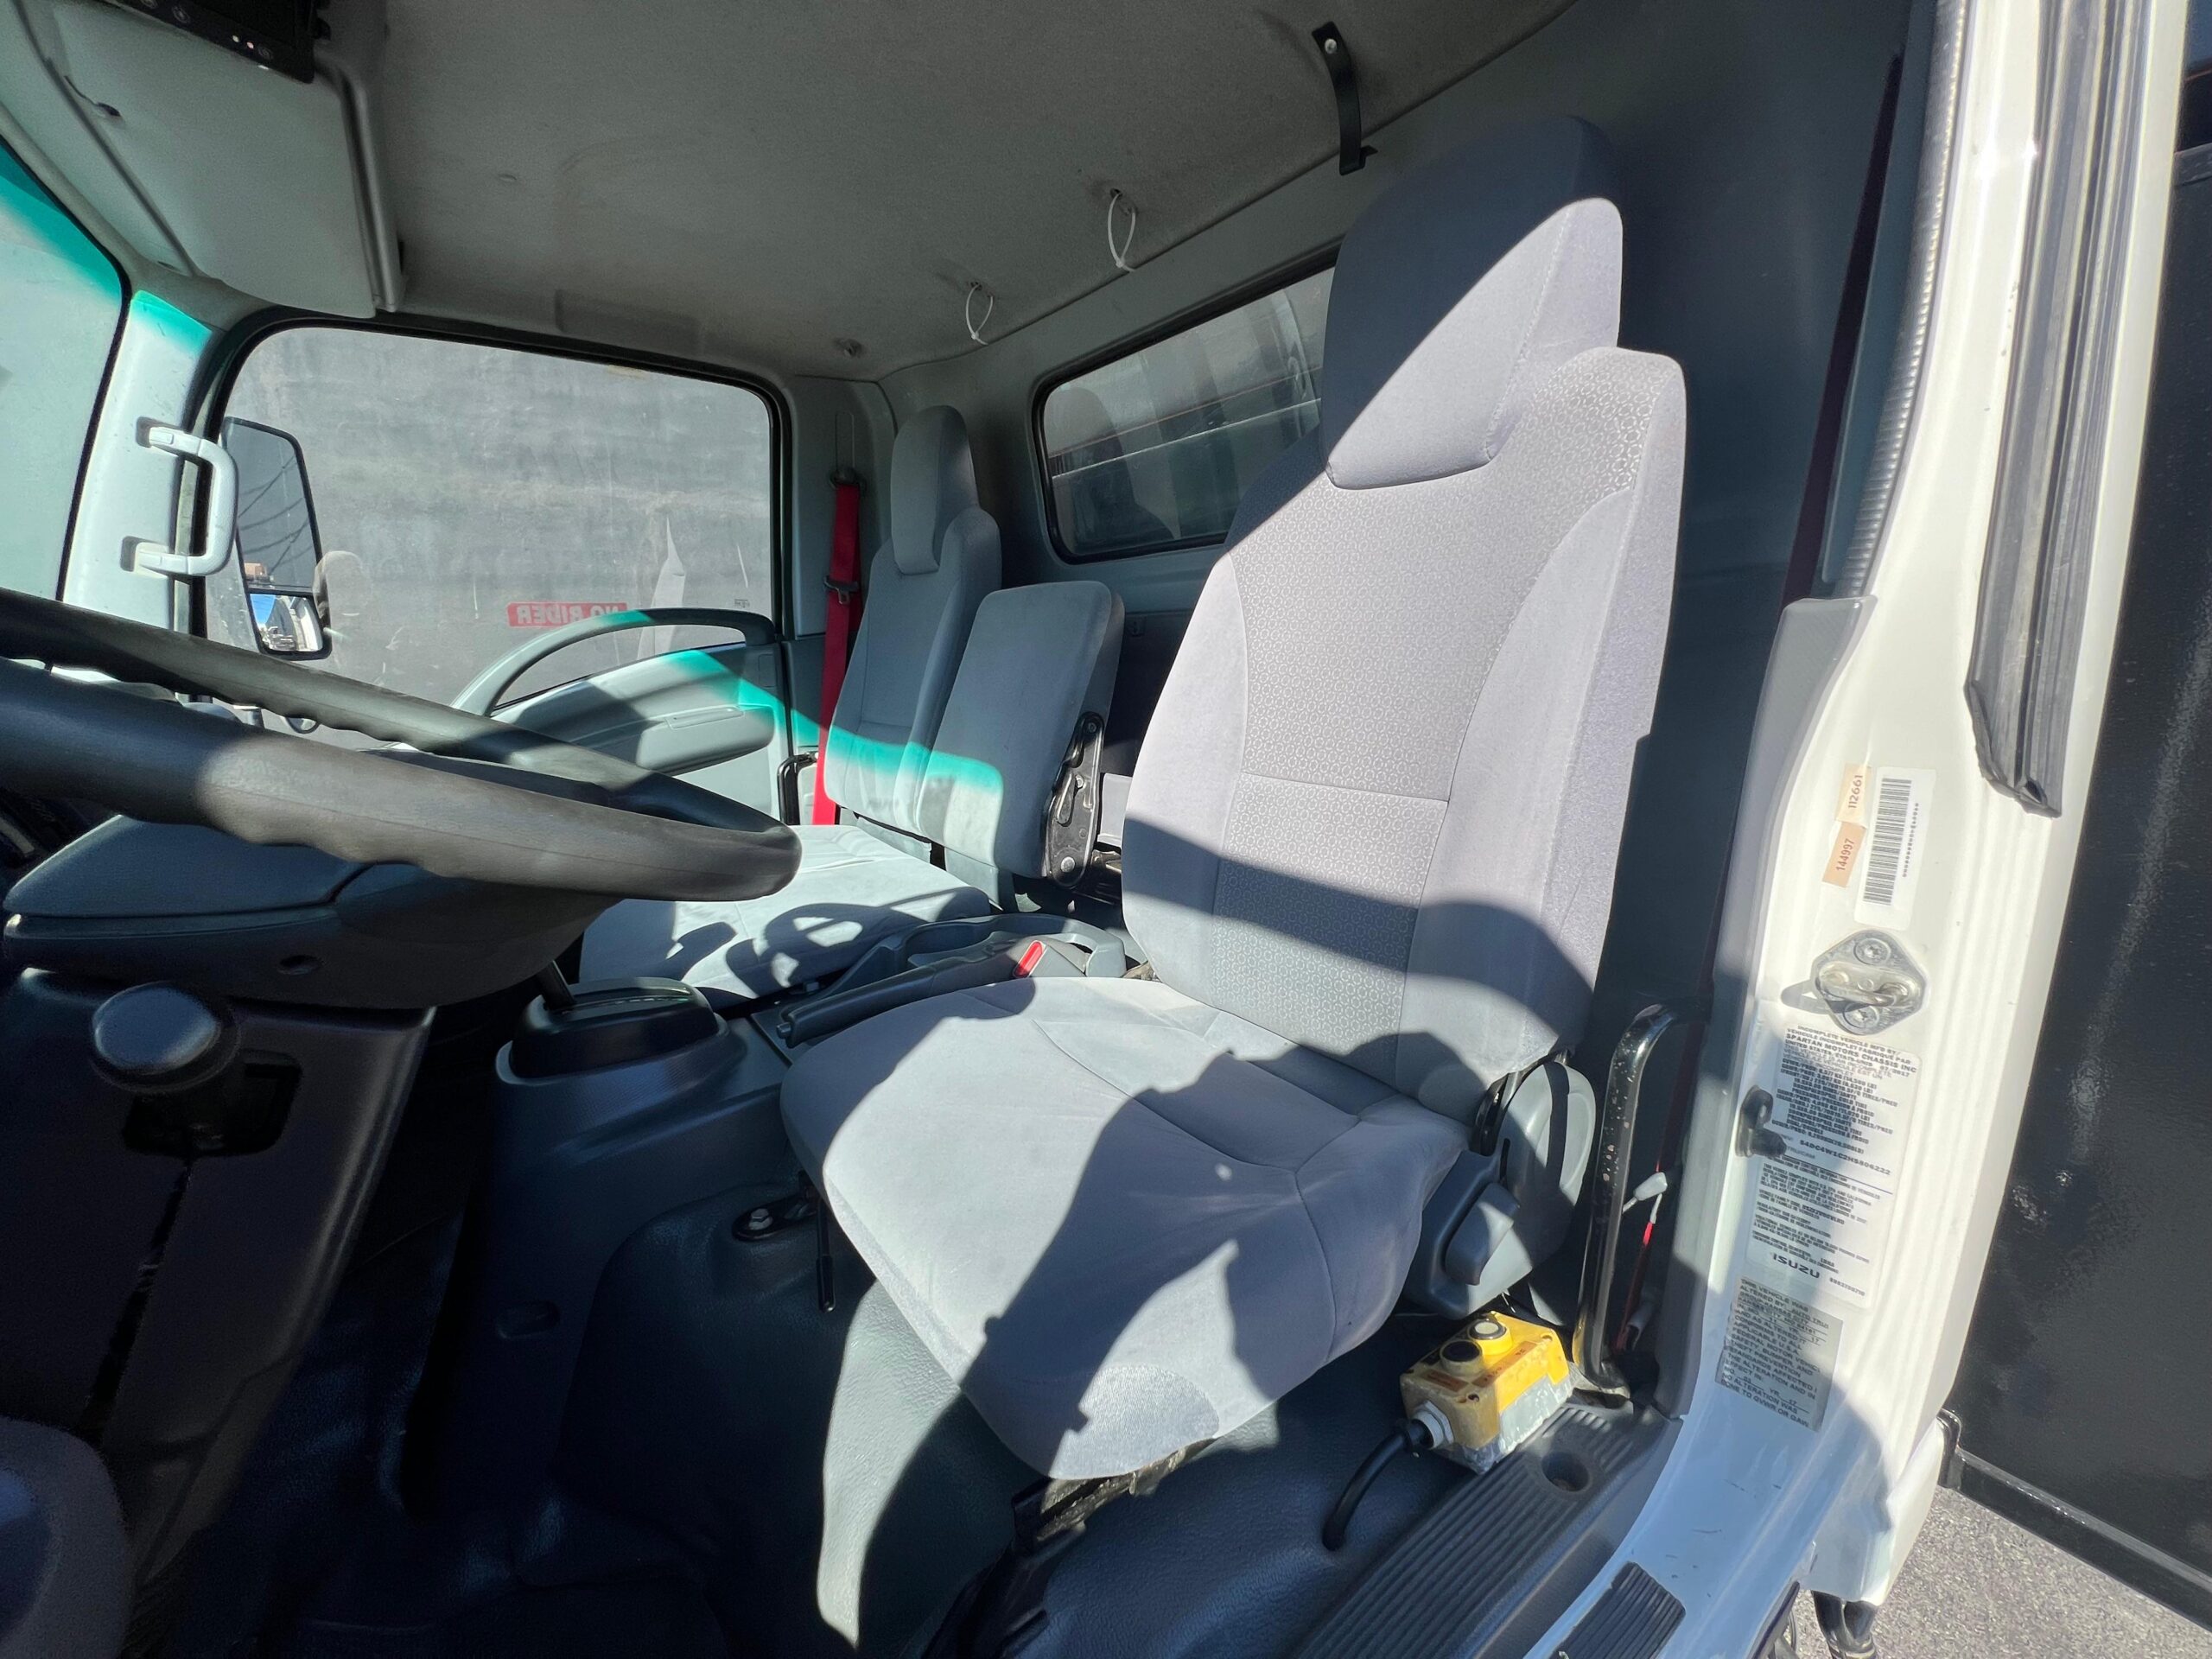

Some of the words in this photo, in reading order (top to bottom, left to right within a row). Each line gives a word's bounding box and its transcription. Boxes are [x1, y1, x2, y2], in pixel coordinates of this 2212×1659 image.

[1848, 774, 1864, 809] 112661
[1836, 838, 1855, 871] 144997
[1786, 1033, 1821, 1047] SPARTAN
[1824, 1043, 1859, 1057] MOTORS
[1862, 1053, 1898, 1068] CHASSIS
[1772, 1253, 1820, 1279] ISUZU
[1739, 1285, 1773, 1302] ALTERED
[1732, 1326, 1764, 1345] FEDERAL
[1766, 1343, 1793, 1358] MOTOR
[1763, 1321, 1797, 1340] ALTERED
[1776, 1333, 1787, 1342] TO
[1789, 1339, 1802, 1350] ALL
[1753, 1351, 1801, 1377] PREVENTION
[1796, 1363, 1814, 1376] AND
[1742, 1360, 1789, 1386] ALTERATION
[1789, 1382, 1805, 1395] AND
[1773, 1368, 1814, 1391] AFFECTED
[1733, 1378, 1779, 1404] ALTERATION
[1781, 1402, 1797, 1414] WAS
[1742, 1389, 1751, 1398] TO
